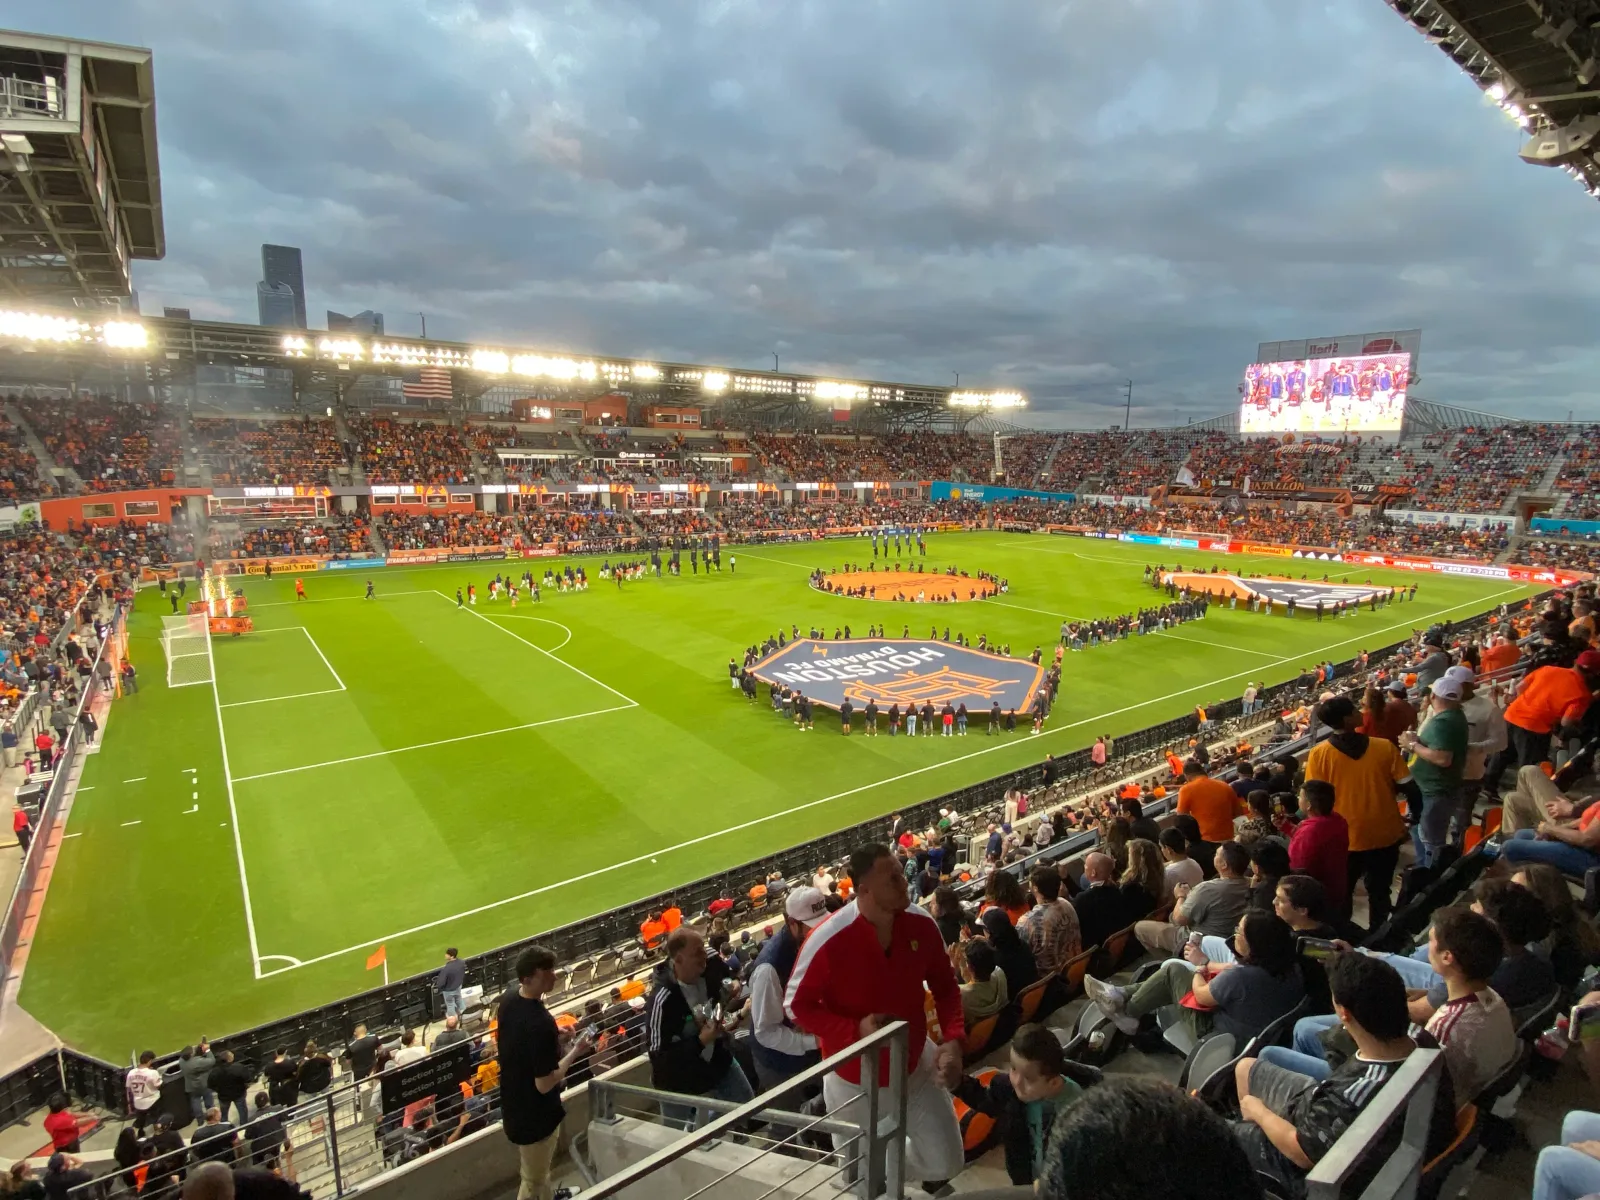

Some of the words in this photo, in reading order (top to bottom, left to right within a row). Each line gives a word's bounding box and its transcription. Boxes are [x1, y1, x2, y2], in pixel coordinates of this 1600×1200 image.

[299, 563, 317, 571] TIRE
[772, 646, 946, 683] HOUSTON
[784, 661, 815, 670] FC
[814, 645, 898, 667] DYNAMO
[401, 1068, 434, 1086] Section
[436, 1060, 453, 1072] 229
[131, 1082, 145, 1094] 27
[401, 1081, 435, 1098] Section
[436, 1072, 454, 1085] 230
